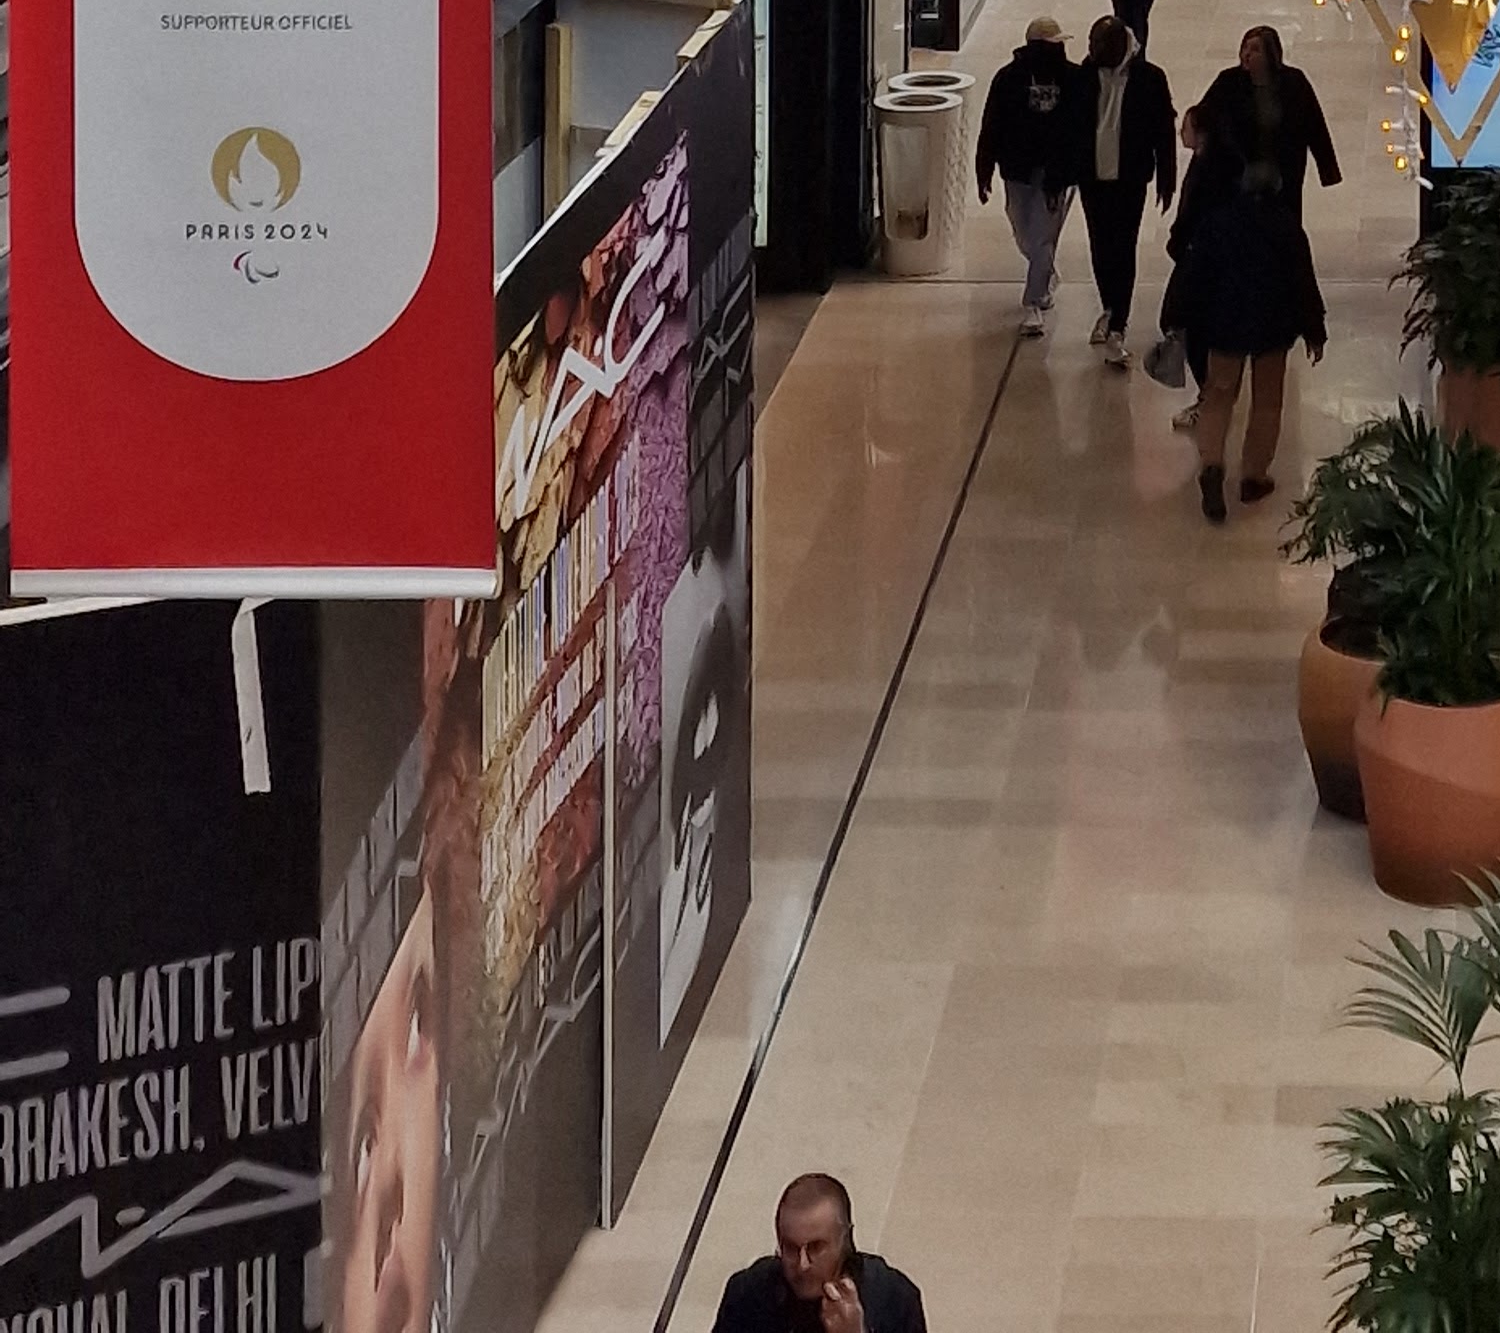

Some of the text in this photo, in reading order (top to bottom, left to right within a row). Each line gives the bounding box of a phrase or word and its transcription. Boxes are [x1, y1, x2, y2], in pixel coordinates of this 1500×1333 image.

[161, 14, 354, 31] SUPPORTEUR OFFICIEL
[186, 224, 329, 241] PARIS 2024
[98, 951, 236, 1063] MATTE
